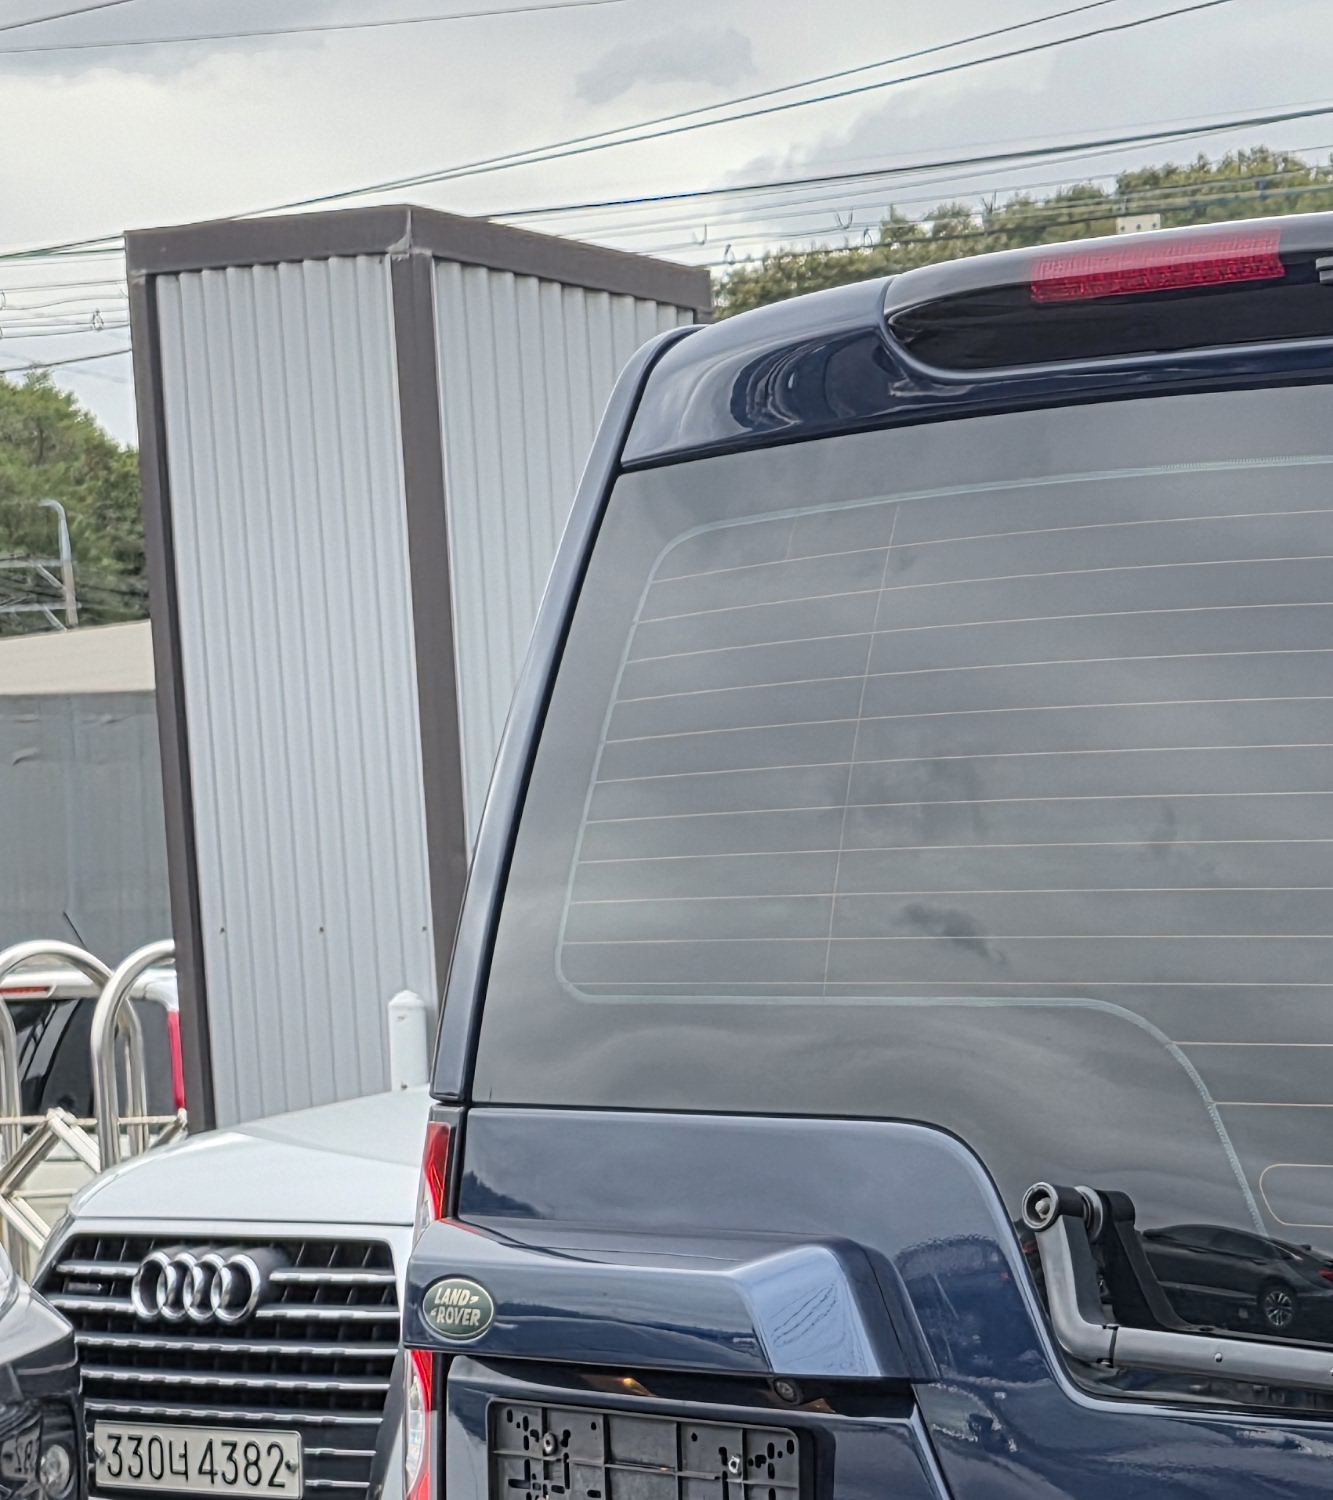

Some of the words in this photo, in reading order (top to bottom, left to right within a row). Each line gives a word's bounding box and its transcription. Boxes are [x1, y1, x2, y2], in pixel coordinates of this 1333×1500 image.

[434, 1286, 471, 1306] LAND
[436, 1305, 481, 1326] ROVER
[198, 1438, 286, 1489] 4382
